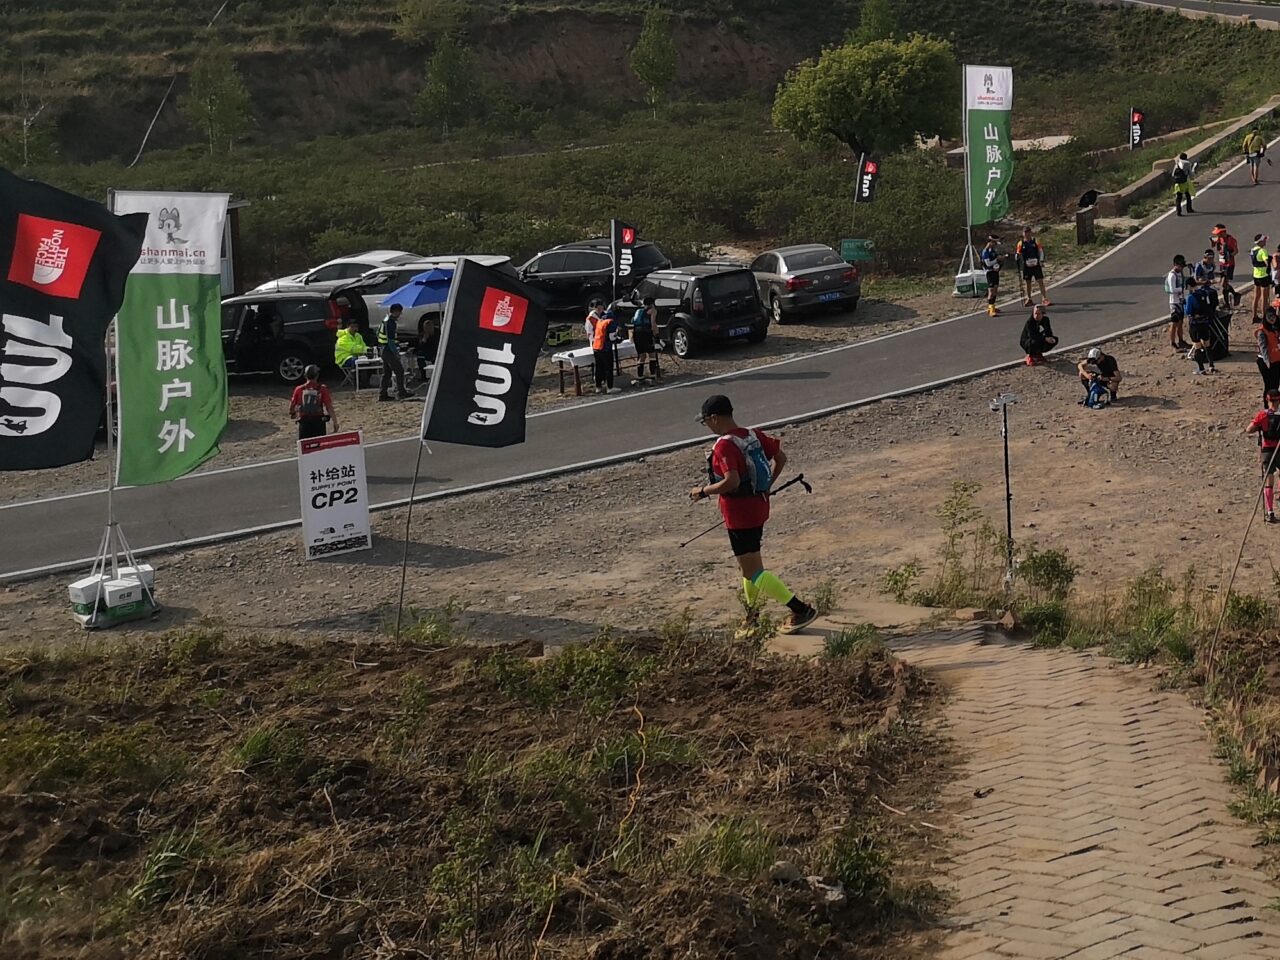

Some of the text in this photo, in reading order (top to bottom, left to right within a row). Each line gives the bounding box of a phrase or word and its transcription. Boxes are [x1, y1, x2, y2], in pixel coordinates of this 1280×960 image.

[983, 122, 1003, 207] 山脉户外
[35, 237, 51, 265] FACE
[44, 229, 65, 268] NORTH
[55, 247, 69, 269] THE
[140, 247, 206, 258] shanmai.cn
[156, 298, 195, 453] 山脉户外
[309, 464, 356, 484] 补给站
[337, 479, 357, 487] POINT
[311, 487, 359, 510] CP2
